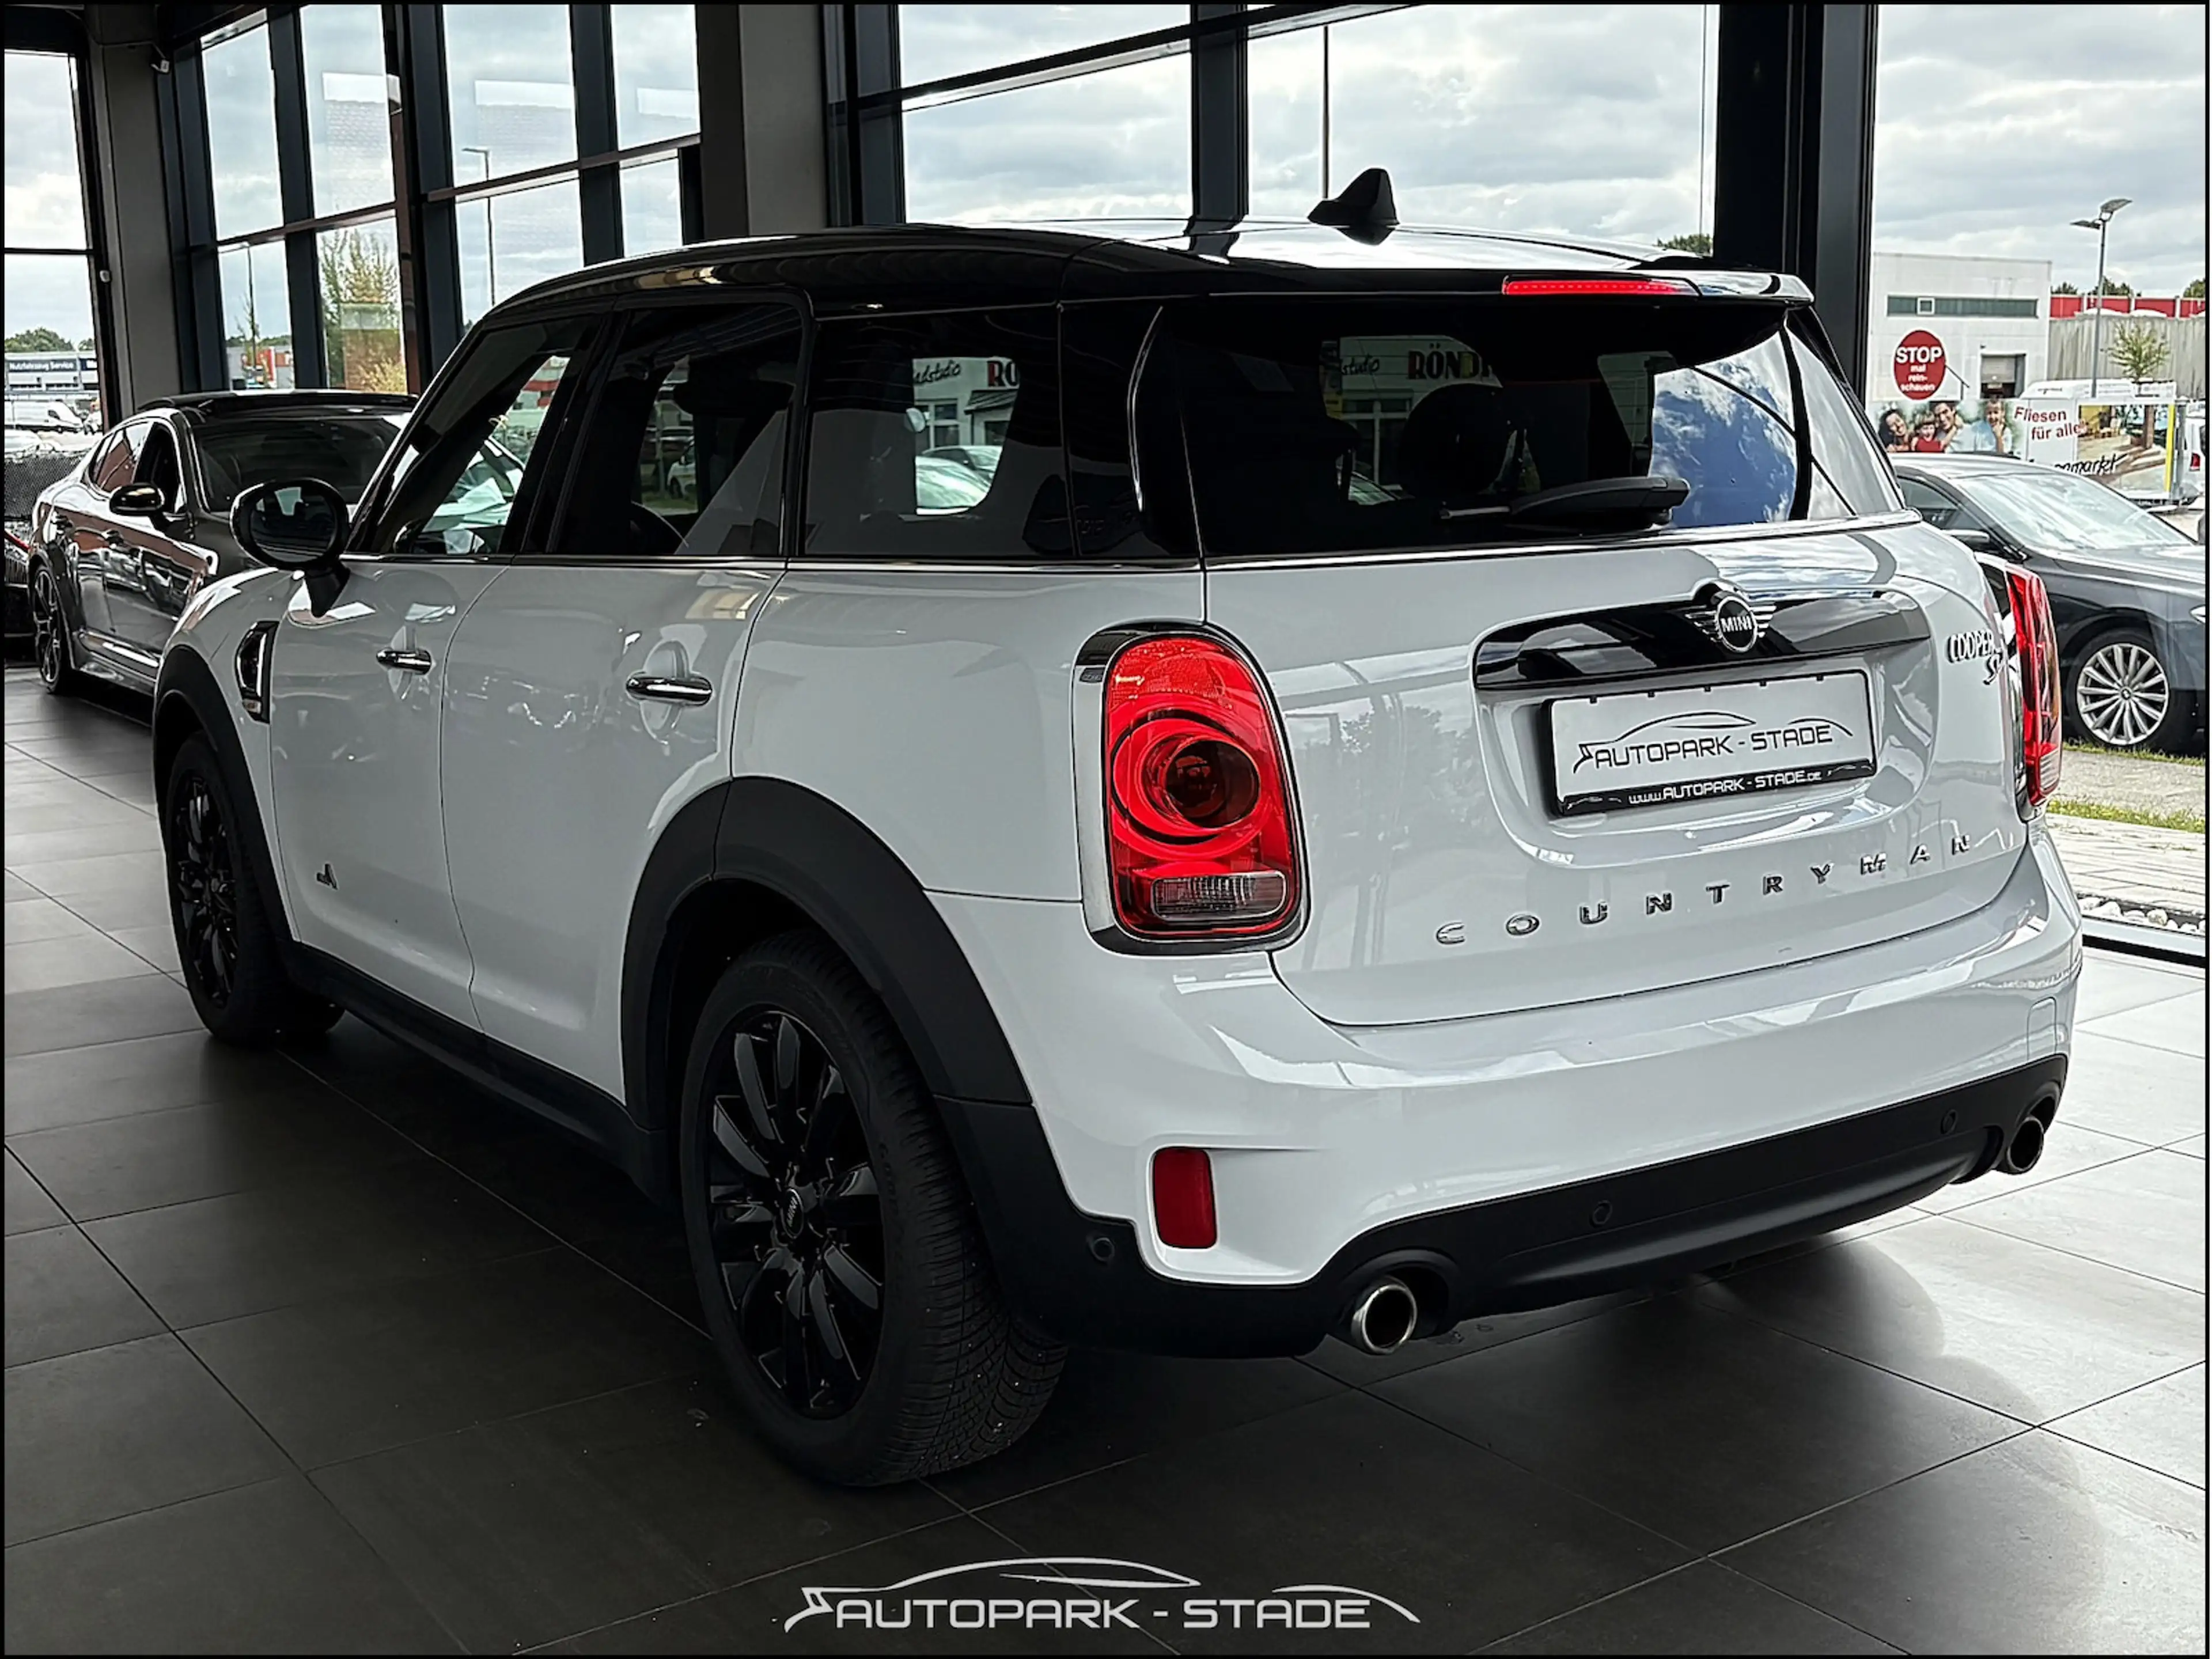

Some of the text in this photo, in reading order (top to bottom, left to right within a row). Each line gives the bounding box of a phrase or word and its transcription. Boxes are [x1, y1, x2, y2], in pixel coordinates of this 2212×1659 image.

[1896, 347, 1942, 363] STOP
[2014, 406, 2067, 422] Fliesen
[2032, 426, 2051, 440] für
[1720, 615, 1752, 633] MINI
[1946, 631, 1993, 664] COOPER
[1594, 734, 1733, 769] AUTOPARK
[1750, 725, 1833, 751] STADE
[1435, 835, 1970, 945] COUNTRYMAN
